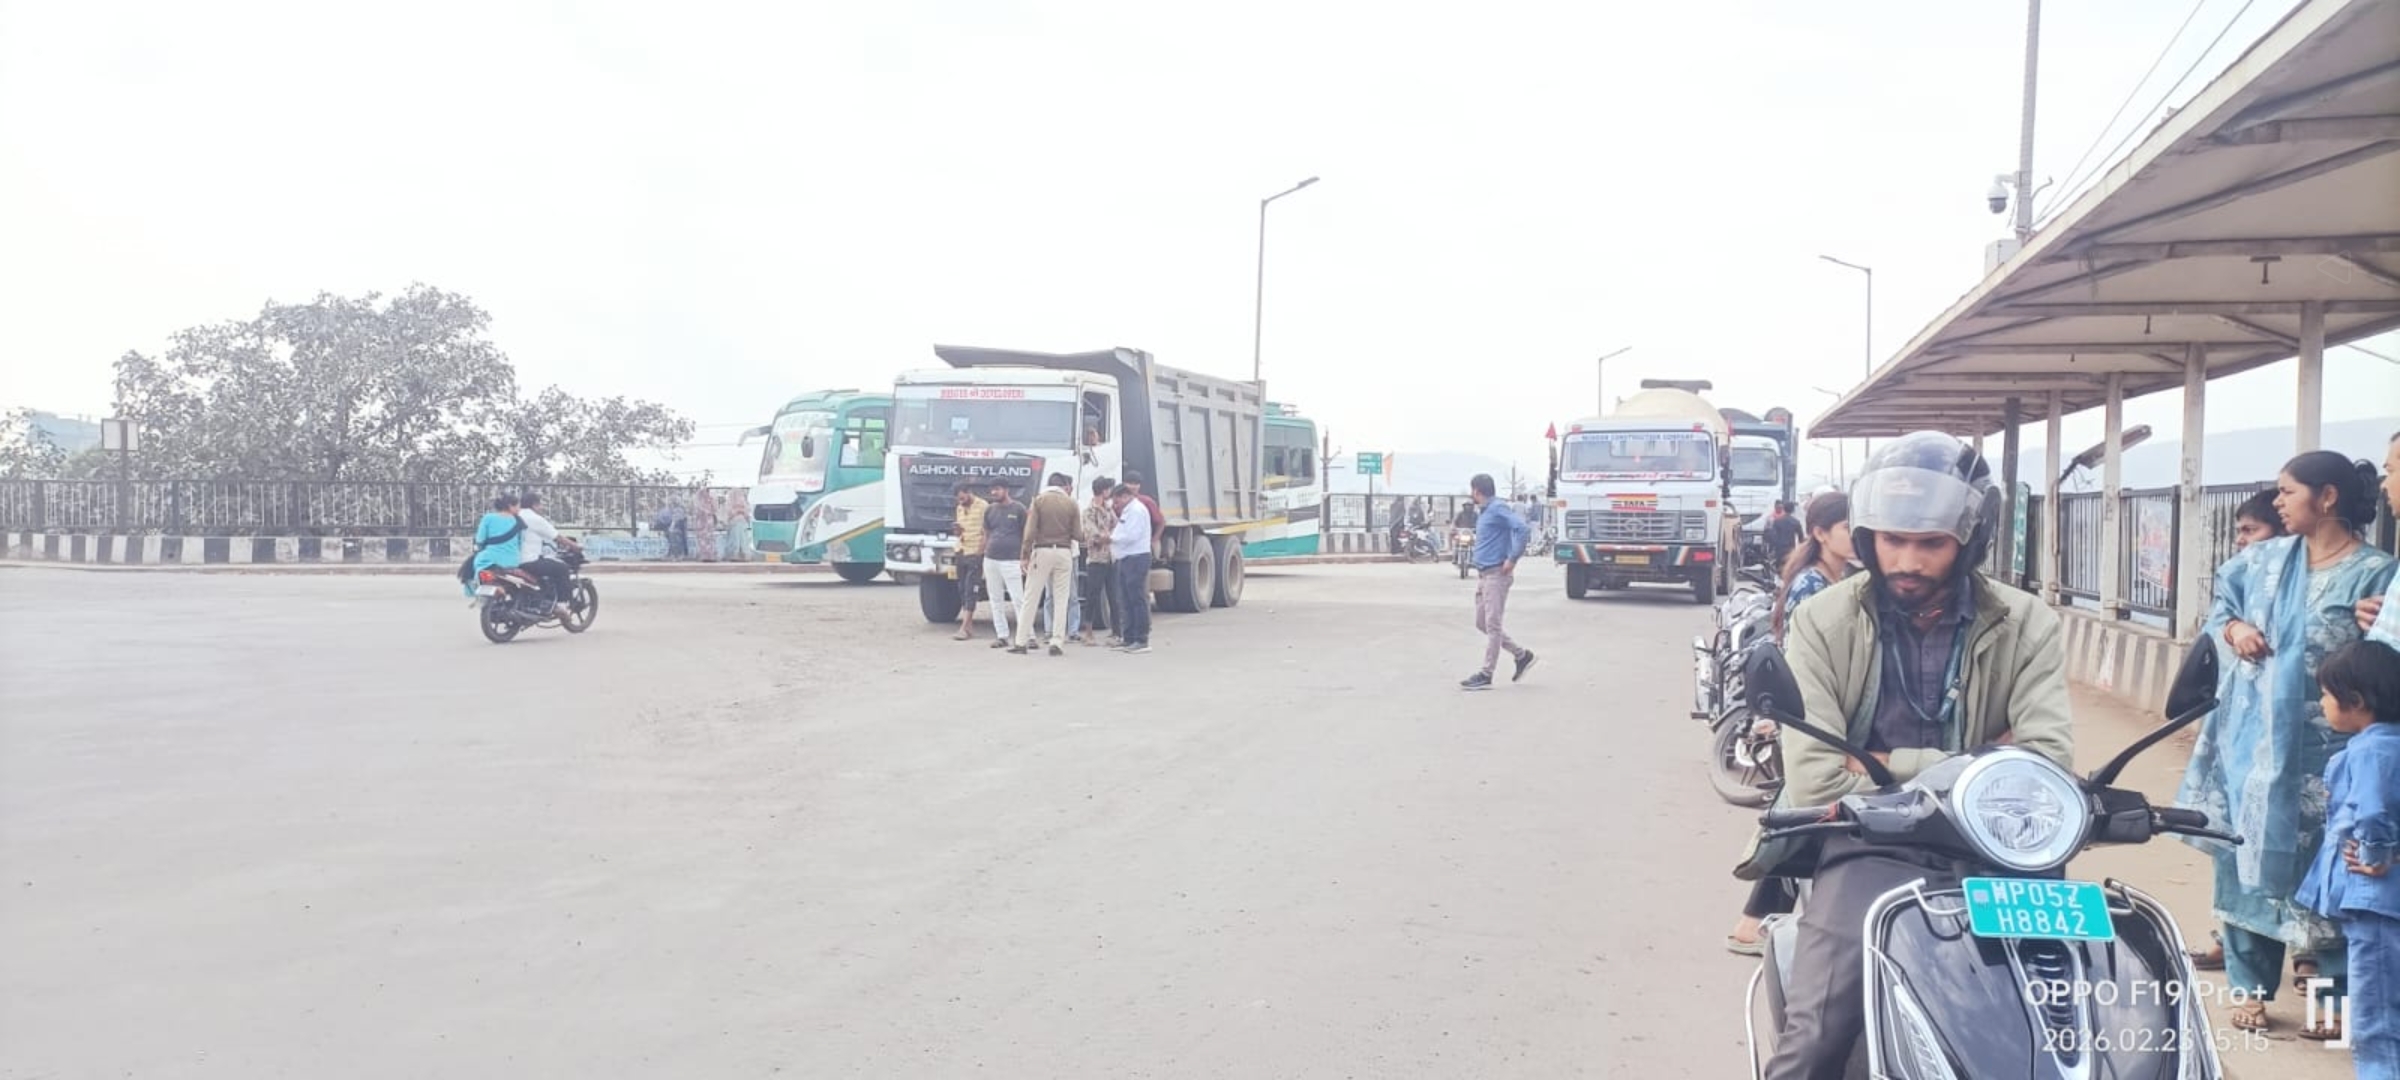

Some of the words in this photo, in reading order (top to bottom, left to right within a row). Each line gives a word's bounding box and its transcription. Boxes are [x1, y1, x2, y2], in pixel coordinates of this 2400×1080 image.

[909, 464, 958, 475] ASHOK
[962, 465, 1031, 476] LEYLAND
[1991, 881, 2083, 908] MP05Z
[1997, 908, 2089, 935] H8842
